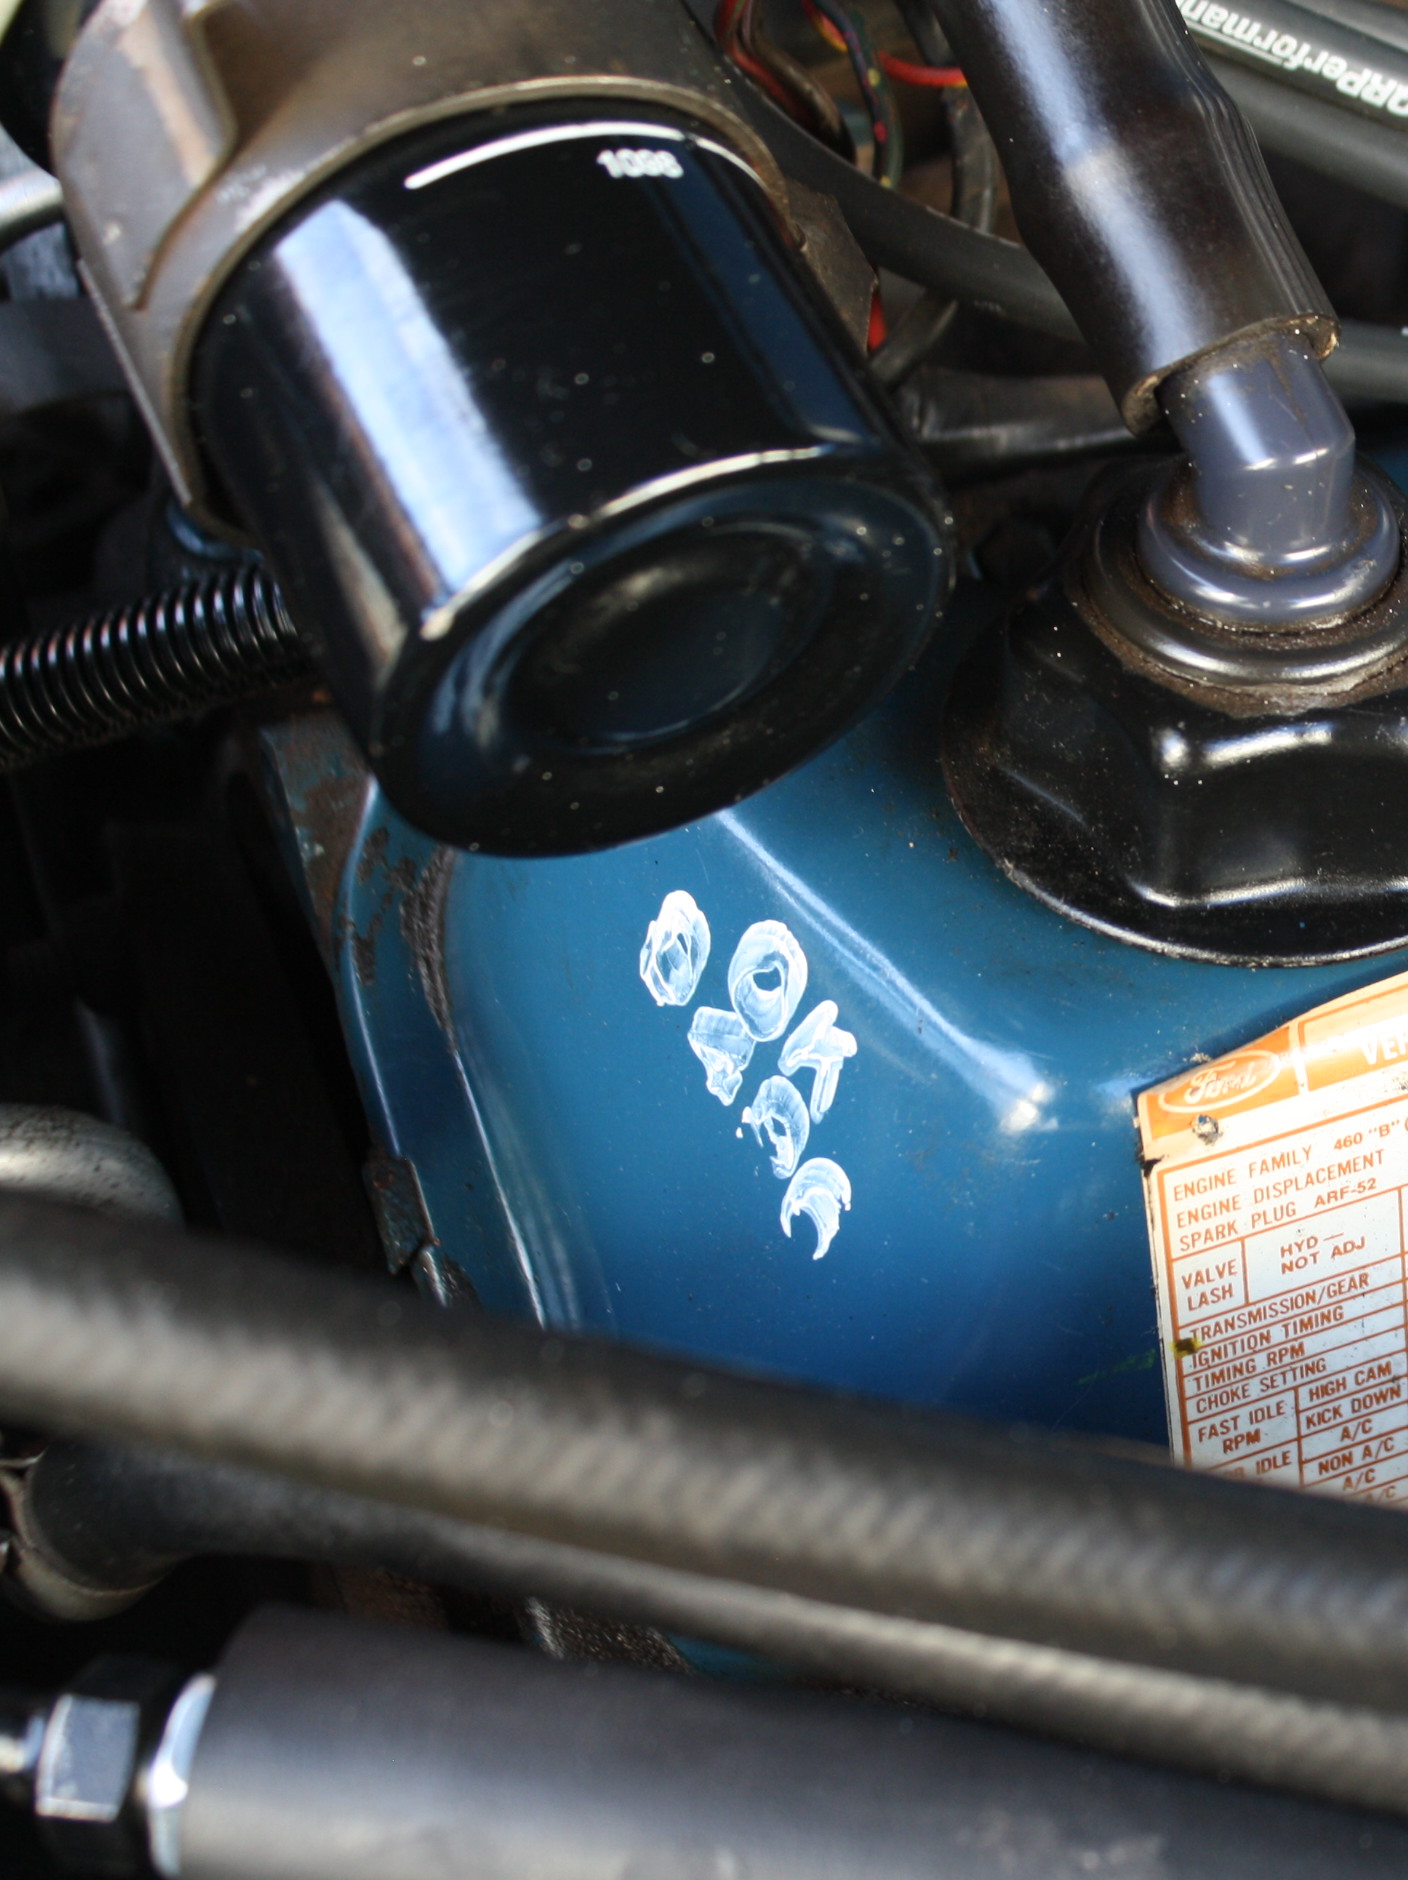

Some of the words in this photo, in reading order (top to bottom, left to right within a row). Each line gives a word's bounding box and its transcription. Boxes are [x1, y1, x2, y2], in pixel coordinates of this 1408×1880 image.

[1184, 1060, 1258, 1103] Ford
[1174, 1168, 1237, 1202] ENGINE
[1249, 1144, 1312, 1178] FAMILY
[1333, 1132, 1363, 1150] 460
[1177, 1194, 1241, 1228] ENGINE
[1254, 1149, 1384, 1204] DISPLACEMENT
[1180, 1220, 1239, 1252] SPARK
[1251, 1202, 1297, 1229] PLUG
[1314, 1178, 1377, 1208] ARF-52
[1182, 1258, 1238, 1291] VALVE
[1280, 1236, 1318, 1258] HYD
[1187, 1283, 1234, 1311] LASH
[1281, 1252, 1319, 1274] NOT
[1331, 1237, 1365, 1259] ADJ
[1190, 1272, 1370, 1342] TRANSMISSION/GEAR
[1192, 1329, 1271, 1369] IGNITION
[1282, 1306, 1344, 1338] TIMING
[1194, 1359, 1256, 1392] TIMING
[1267, 1341, 1305, 1368] RPM
[1196, 1383, 1251, 1415] CHOKE
[1260, 1358, 1326, 1392] SETTING
[1309, 1376, 1347, 1402] HIGH
[1354, 1361, 1392, 1385] CAM
[1198, 1416, 1240, 1443] FAST
[1250, 1400, 1286, 1426] IDLE
[1306, 1405, 1343, 1430] KICK
[1351, 1385, 1401, 1414] DOWN
[1223, 1429, 1261, 1455] RPM
[1340, 1418, 1373, 1442] A/C
[1256, 1450, 1292, 1476] IDLE
[1318, 1451, 1353, 1476] NON
[1361, 1437, 1395, 1461] A/C
[1342, 1468, 1376, 1491] A/C
